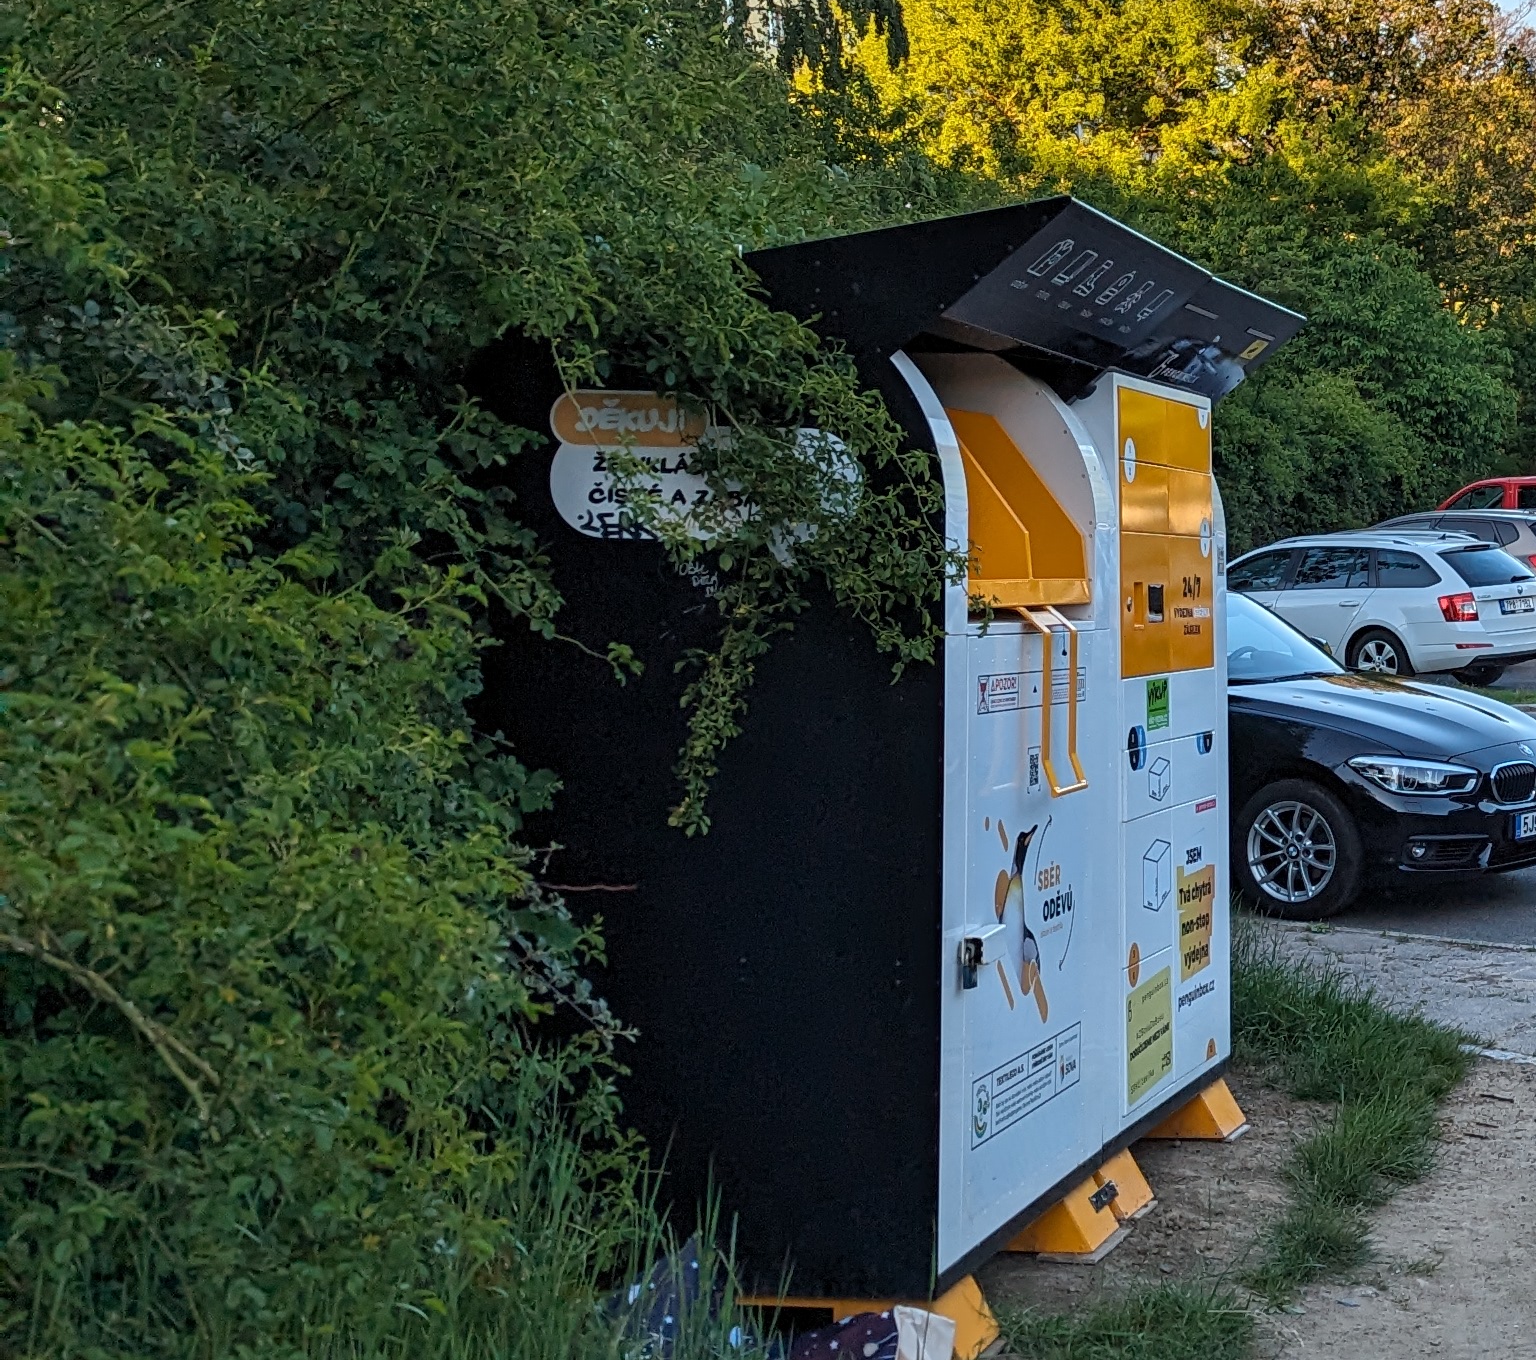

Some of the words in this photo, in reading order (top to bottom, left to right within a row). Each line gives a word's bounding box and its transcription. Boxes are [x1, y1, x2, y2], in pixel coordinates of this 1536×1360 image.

[575, 398, 686, 434] DĚKUJI
[588, 482, 663, 505] ČISÉ
[671, 489, 687, 506] A
[1183, 574, 1201, 600] 24/7
[1186, 846, 1202, 865] JSEM
[1038, 861, 1061, 891] SBĚR
[1042, 884, 1073, 922] ODĚVŮ
[1179, 884, 1191, 905] Tvá
[1191, 877, 1212, 902] chytrá
[1181, 912, 1210, 936] non-stop
[1184, 942, 1209, 970] výdejna
